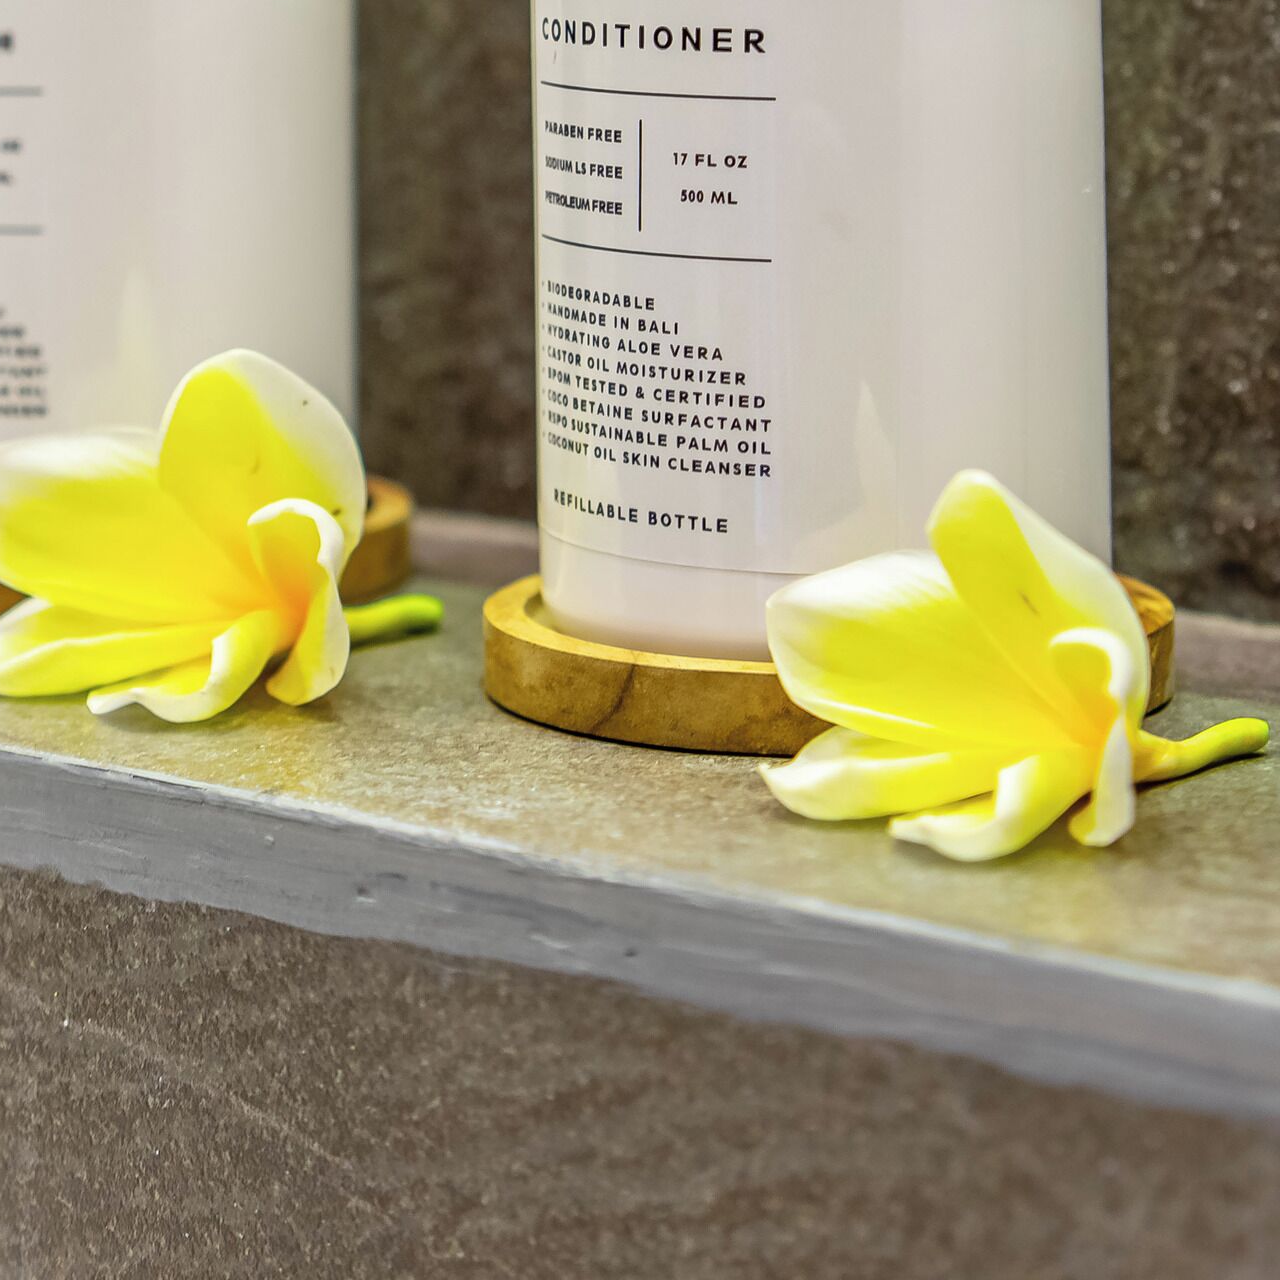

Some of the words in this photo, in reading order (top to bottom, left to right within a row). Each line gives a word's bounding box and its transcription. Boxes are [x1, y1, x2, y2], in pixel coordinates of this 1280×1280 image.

[542, 17, 766, 53] CONDITIONER
[545, 120, 584, 139] PARABEN
[588, 128, 622, 143] FREE
[575, 161, 587, 175] LS
[590, 163, 623, 179] FREE
[673, 153, 688, 166] 17
[695, 154, 717, 167] FL
[724, 155, 748, 168] OZ
[545, 190, 590, 211] PETROLEUM
[592, 199, 623, 215] FREE
[680, 189, 704, 203] 500
[711, 191, 738, 205] ML
[547, 280, 655, 311] BIODEGRADABLE
[547, 302, 606, 327] HANDMADE
[614, 316, 629, 330] IN
[638, 319, 679, 335] BALI
[547, 324, 610, 349] HYDRATING
[617, 339, 661, 356] ALOE
[670, 344, 723, 361] VERA
[547, 345, 581, 367] CASTOR
[587, 357, 609, 372] OIL
[617, 361, 747, 386] MOISTURIZER
[576, 377, 628, 397] TESTED
[635, 386, 645, 399] &
[653, 388, 766, 409] CERTIFIED
[573, 395, 633, 420] BETAINE
[641, 410, 772, 433] SURFACTANT
[571, 418, 668, 447] SUSTAINABLE
[676, 436, 729, 453] PALM
[737, 441, 771, 455] OIL
[547, 432, 589, 456] COCONUT
[594, 447, 616, 462] OIL
[623, 452, 660, 469] SKIN
[668, 458, 771, 477] CLEANSER
[554, 489, 638, 523] REFILLABLE
[648, 511, 729, 534] BOTTLE
